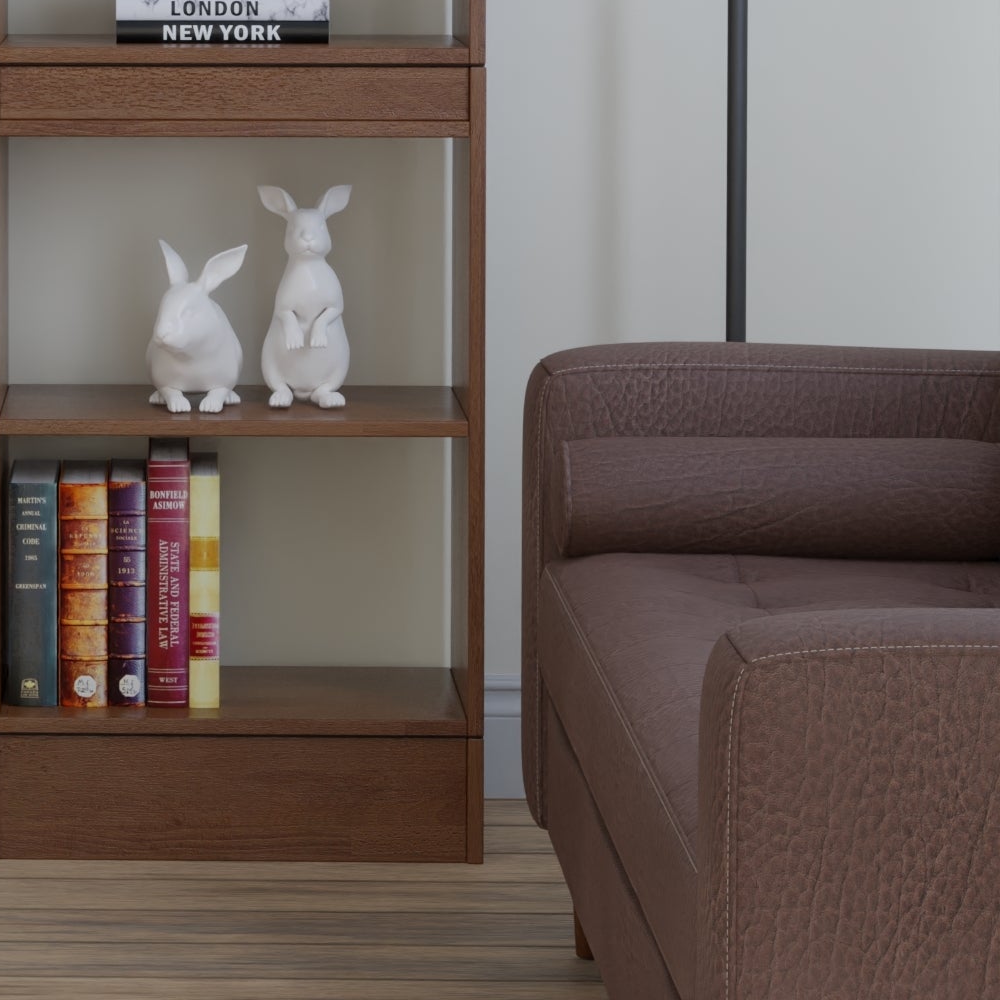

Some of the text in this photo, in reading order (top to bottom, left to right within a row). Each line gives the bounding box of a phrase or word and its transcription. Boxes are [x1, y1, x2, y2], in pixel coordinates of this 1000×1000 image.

[171, 0, 259, 16] LONDON
[163, 25, 281, 40] NEW YORK
[149, 489, 189, 500] BONFIELD
[17, 496, 47, 504] MARTIN'S
[152, 500, 186, 510] ASIMOW
[16, 523, 47, 531] CRIMINAL
[22, 537, 40, 545] CODE
[158, 540, 169, 650] ADMINISTRATIVE LAW
[169, 541, 180, 648] STATE AND FEDERAL
[158, 676, 179, 684] WEST
